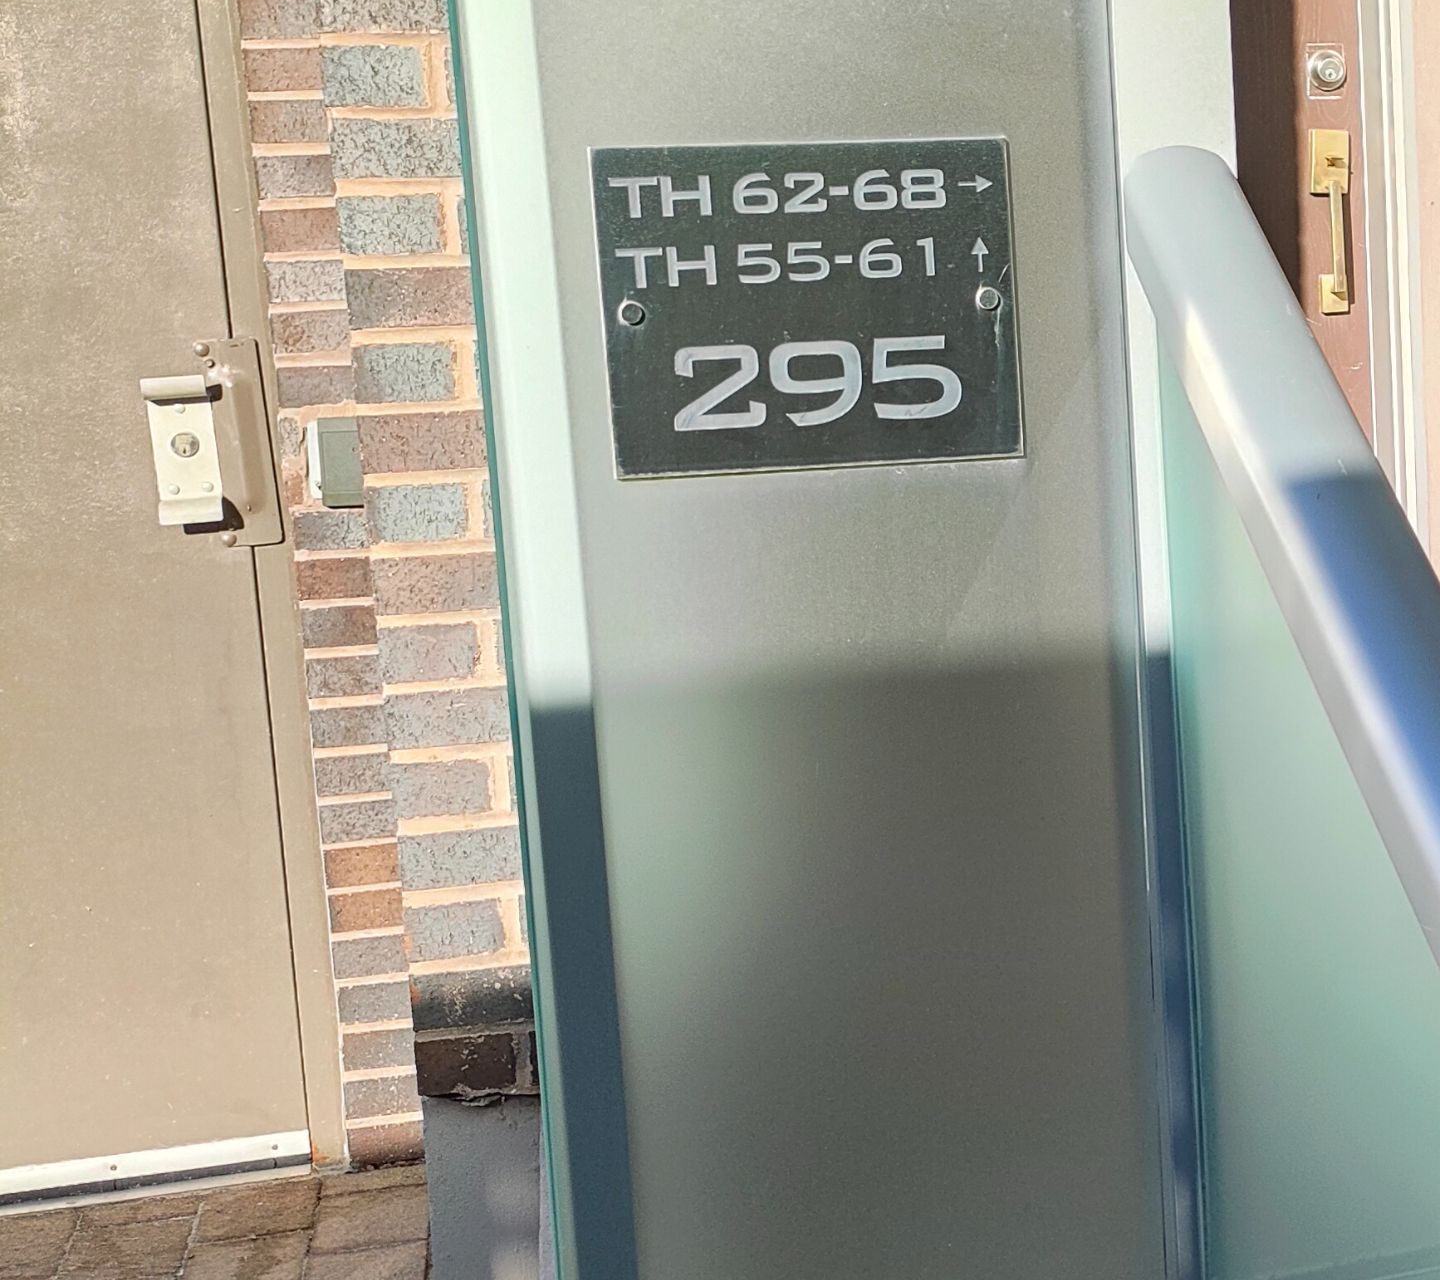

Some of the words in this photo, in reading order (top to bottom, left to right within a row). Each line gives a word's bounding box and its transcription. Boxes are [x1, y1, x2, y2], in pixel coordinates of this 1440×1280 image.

[608, 175, 712, 219] TH
[732, 168, 947, 214] 62-68
[615, 245, 717, 289] TH
[736, 237, 936, 284] 55-61
[674, 335, 962, 432] 295
